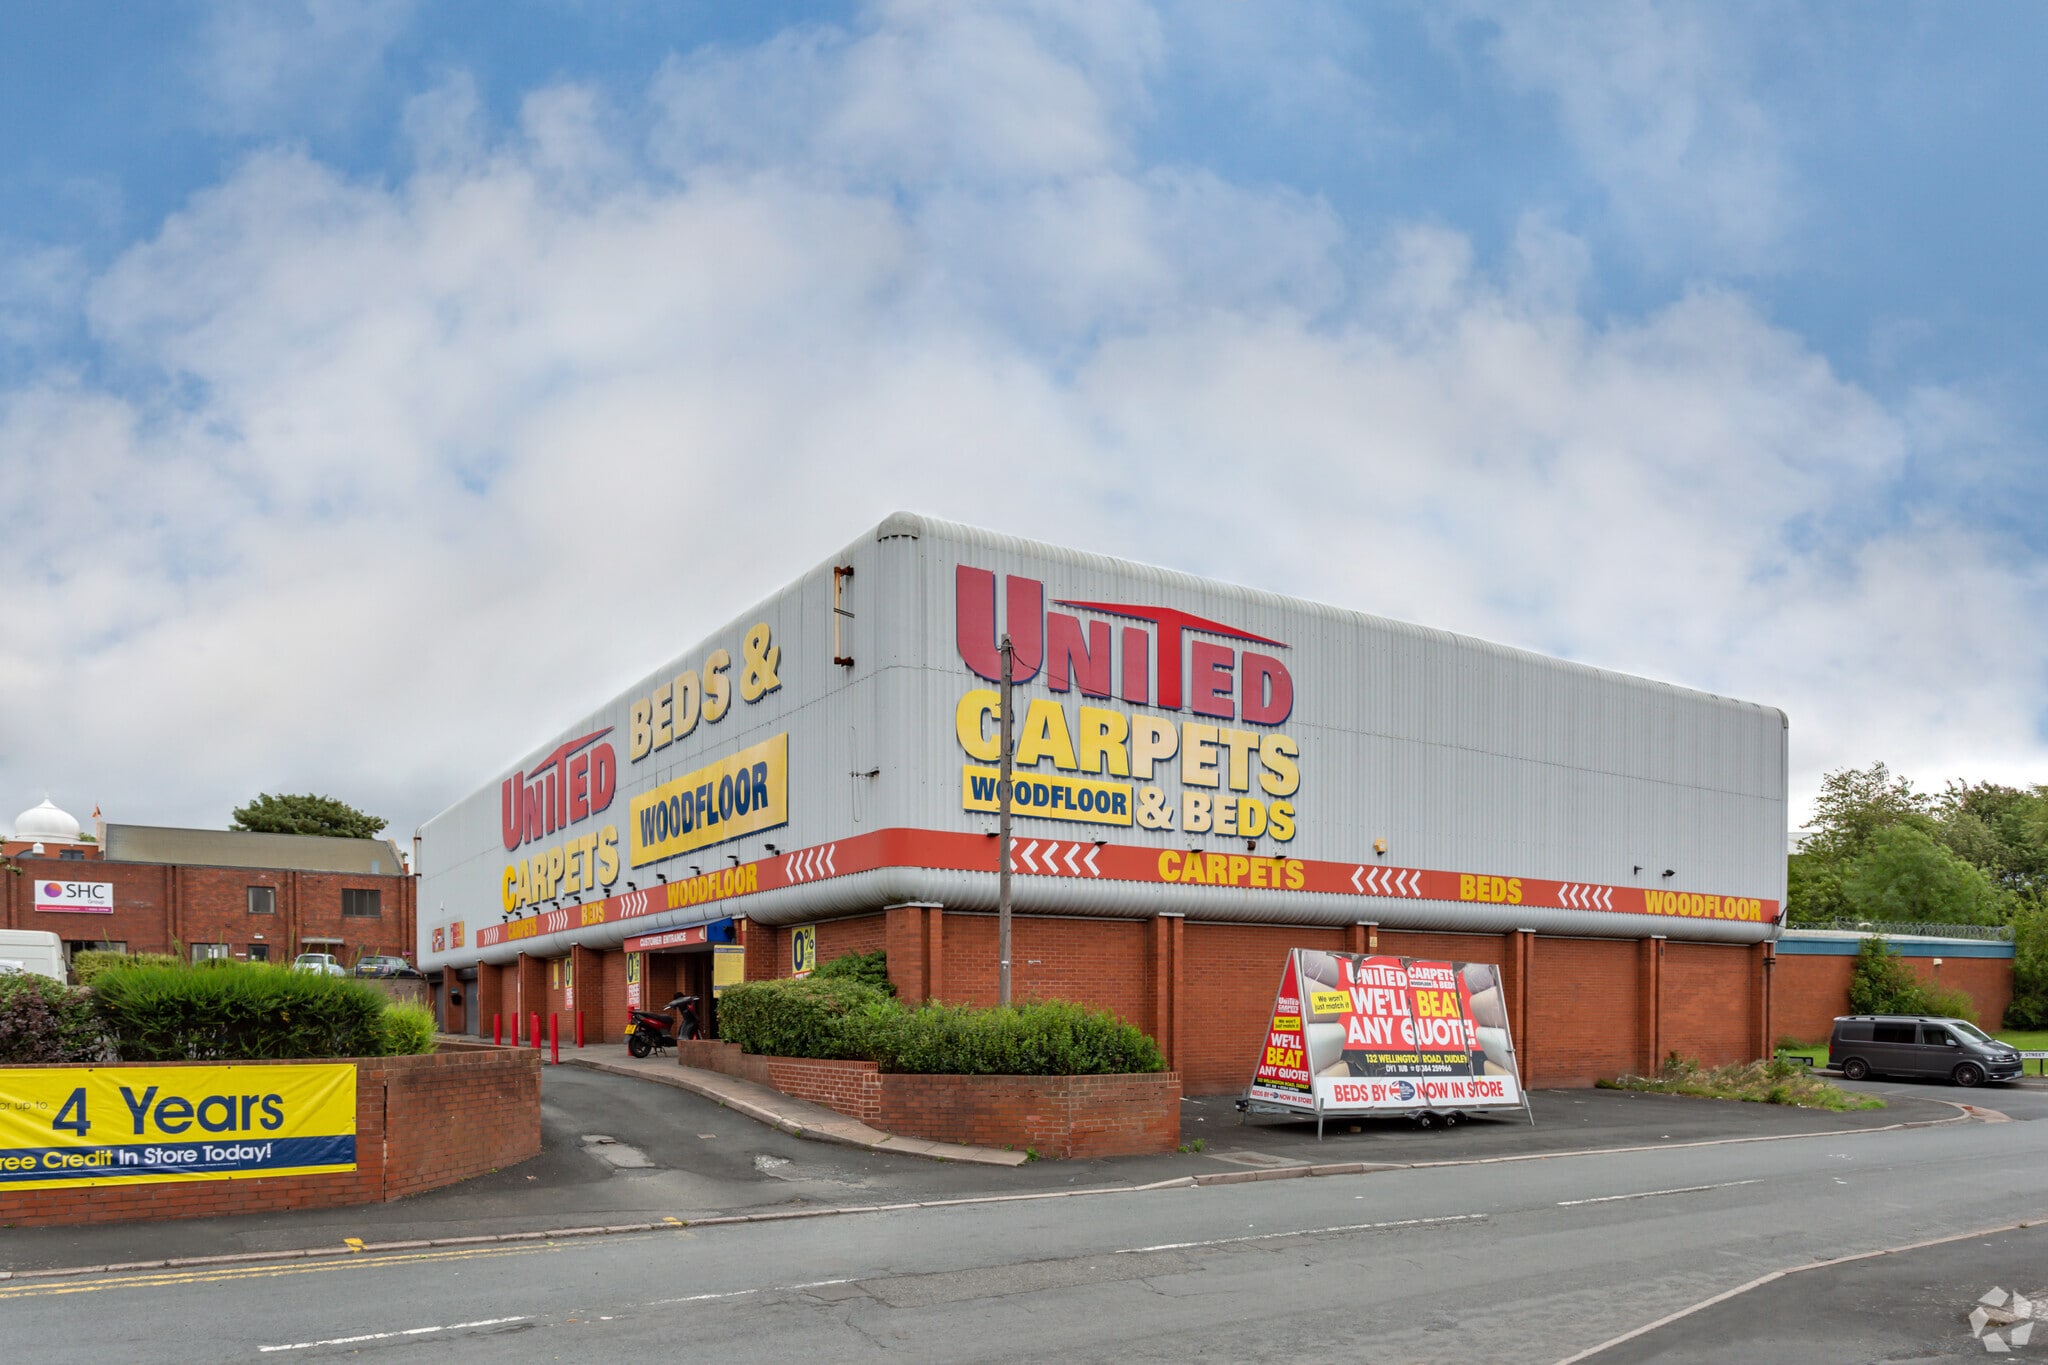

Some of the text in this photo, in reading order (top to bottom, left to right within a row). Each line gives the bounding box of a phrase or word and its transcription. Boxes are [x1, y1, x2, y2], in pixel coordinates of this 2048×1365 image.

[956, 563, 1294, 727] UNITED
[630, 622, 782, 764] BEDS &
[956, 689, 1300, 797] CARPETS
[502, 726, 616, 851] UNITED
[640, 760, 768, 847] WOODFLOOR
[971, 776, 1295, 842] WOODFLOOR & BEDS
[502, 824, 619, 913] CARPETS
[1158, 850, 1305, 889] CARPETS
[66, 884, 104, 899] SHC
[667, 864, 757, 909] WOODFLOOR
[1460, 874, 1522, 904] BEDS
[581, 901, 605, 926] BEDS
[1645, 890, 1761, 921] WOODFLOOR
[507, 917, 537, 940] CARPETS
[794, 928, 814, 971] 0%
[1345, 962, 1408, 987] UNITED
[1315, 1003, 1326, 1011] just
[1327, 1001, 1343, 1010] match
[1349, 987, 1462, 1018] WE'LL BEAT
[1271, 1033, 1301, 1049] WE'LL
[1348, 1017, 1476, 1046] ANY QUOTE!
[1266, 1047, 1303, 1068] BEAT
[1366, 1054, 1378, 1063] 132
[1259, 1065, 1308, 1081] ANY QUOTE!
[15, 1102, 31, 1111] up
[35, 1100, 48, 1110] to
[1334, 1084, 1368, 1102] BEDS
[1371, 1084, 1387, 1102] BY
[1415, 1083, 1449, 1100] NOW
[1451, 1082, 1464, 1098] IN
[1467, 1081, 1504, 1098] STORE
[52, 1086, 284, 1136] 4 Years
[43, 1149, 113, 1169] Credit
[120, 1149, 138, 1165] In
[144, 1146, 198, 1164] Store
[202, 1143, 273, 1163] Today!
